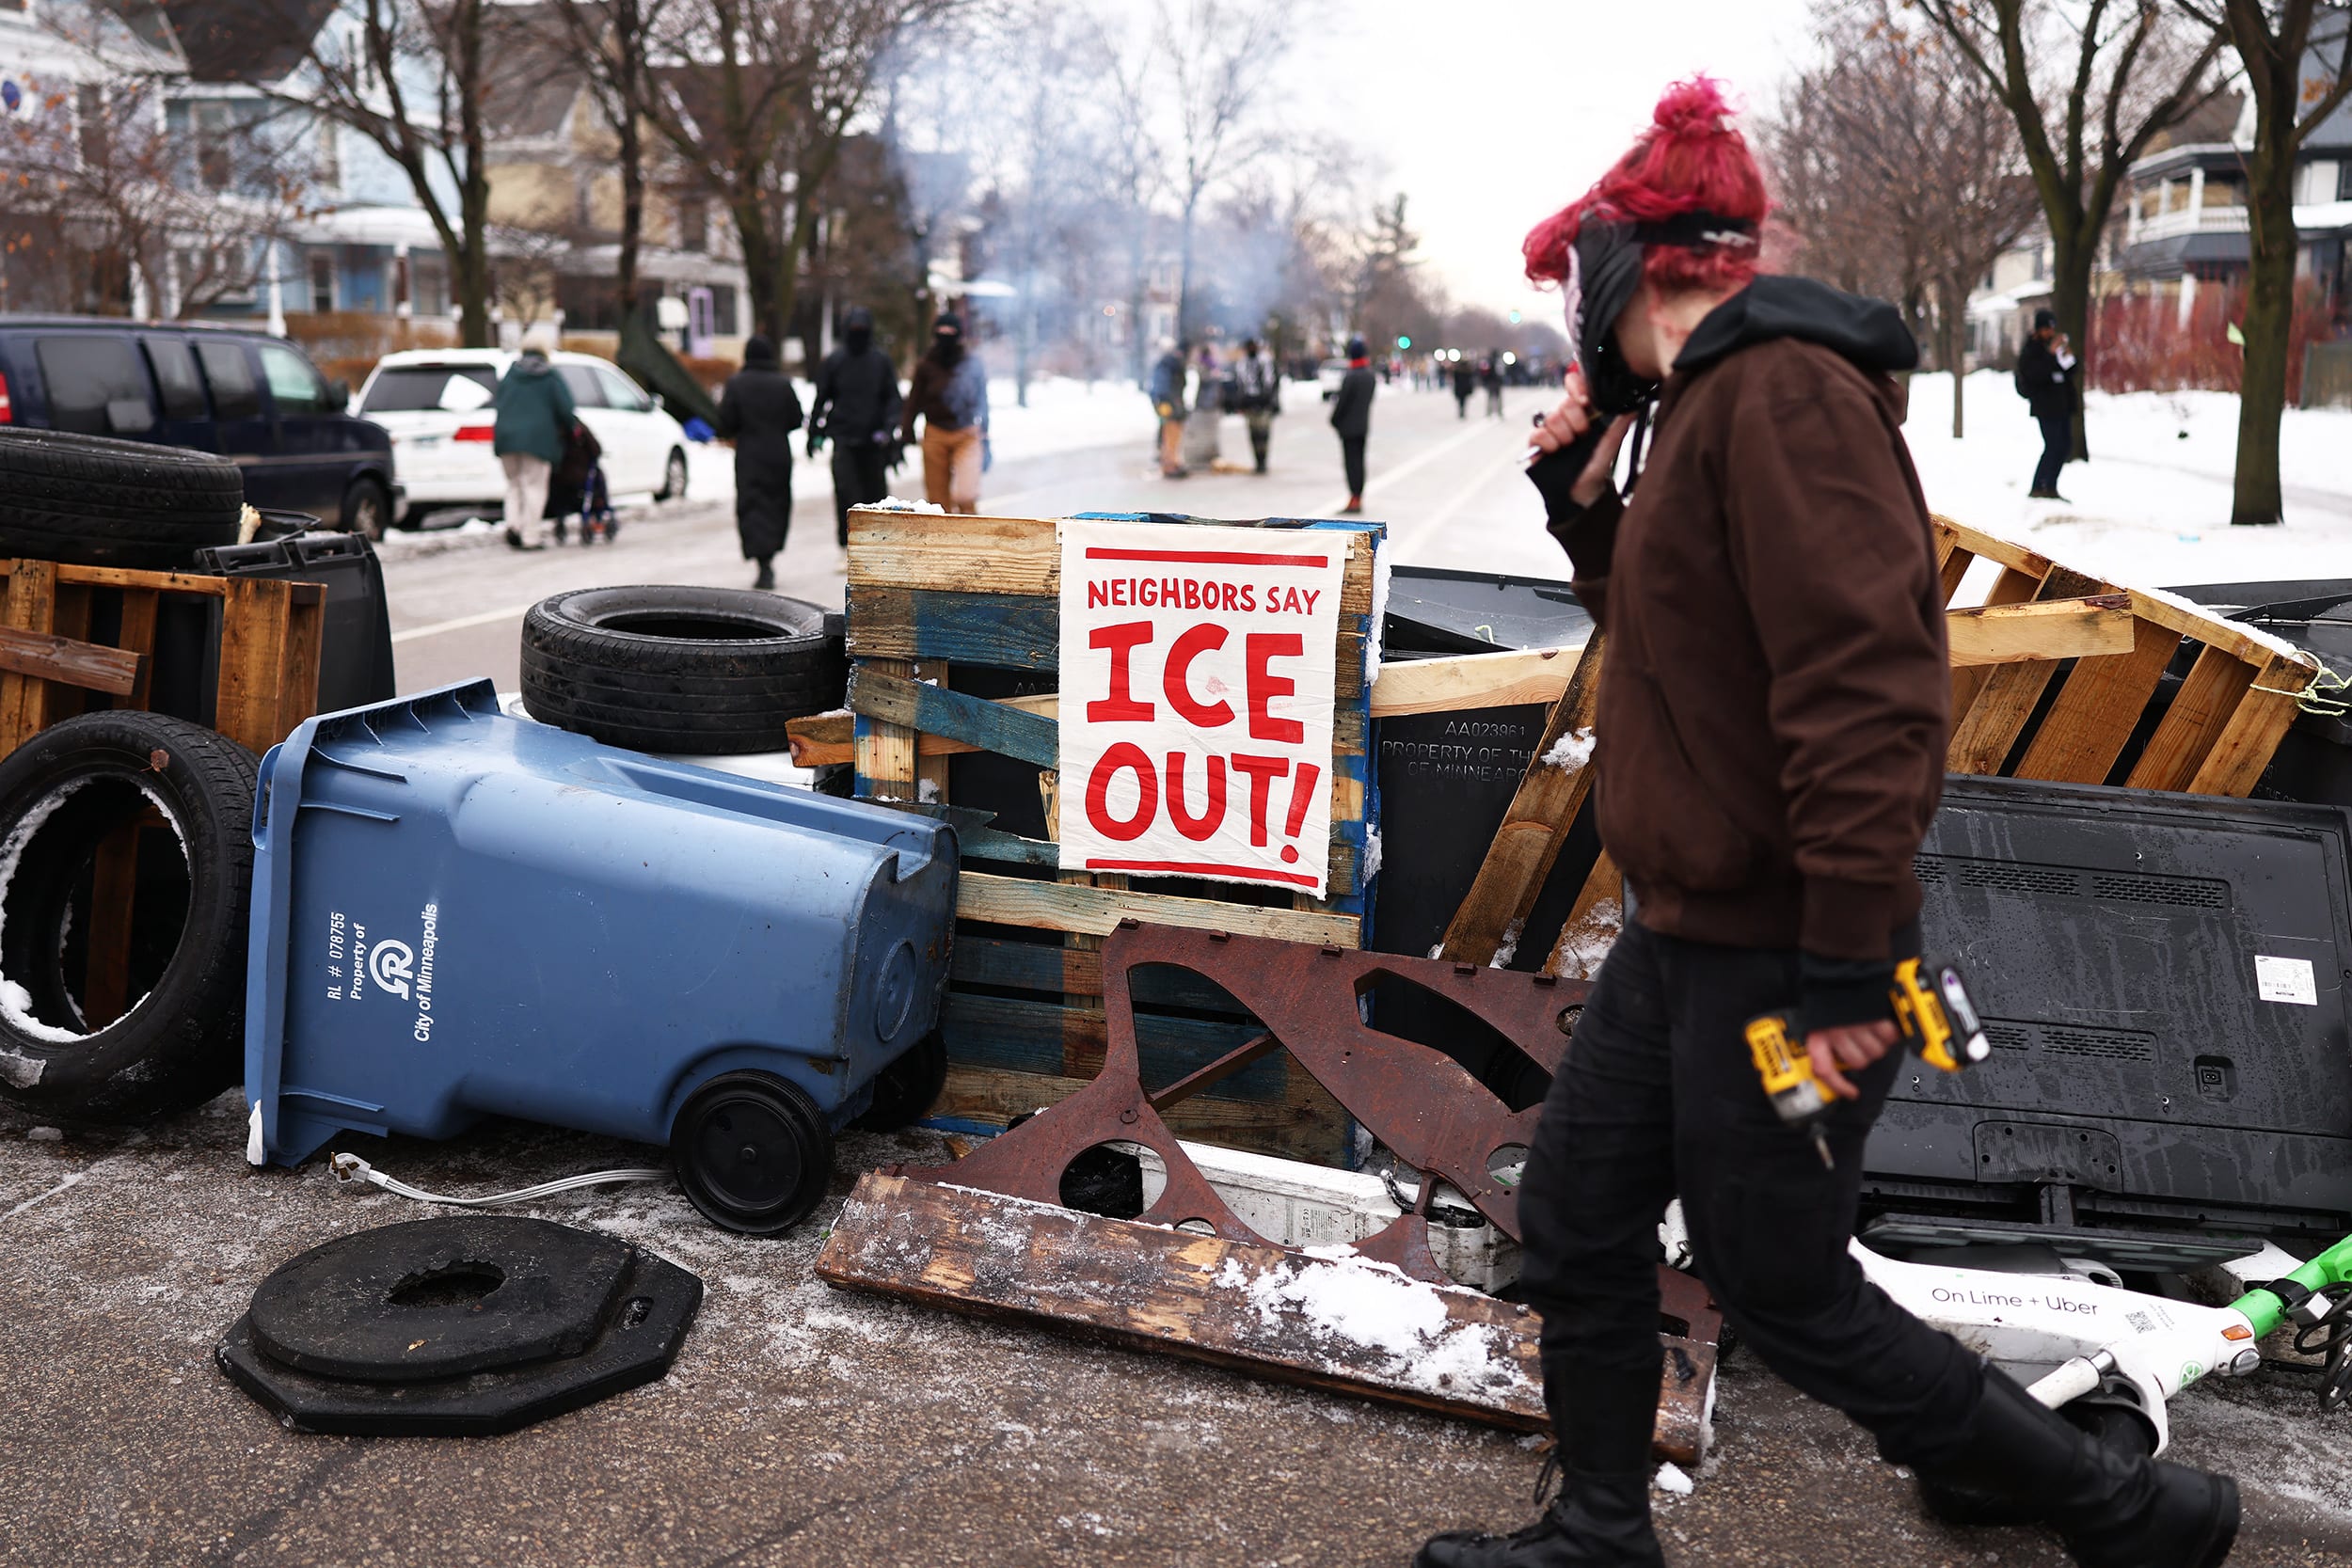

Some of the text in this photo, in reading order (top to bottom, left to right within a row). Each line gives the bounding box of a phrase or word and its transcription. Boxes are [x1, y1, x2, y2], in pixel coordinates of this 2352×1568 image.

[1088, 578, 1321, 616] NEIGHBORS SAY
[1087, 620, 1305, 744] ICE
[1382, 740, 1537, 765] PROPERTY OF TH
[1408, 761, 1430, 776] OF
[1085, 741, 1321, 864] OUT!
[326, 911, 346, 1001] RL # 078755
[350, 922, 367, 1001] Property of
[414, 903, 439, 1042] City of Minneapolis
[1931, 1288, 1965, 1304] On
[1969, 1290, 2023, 1307] Lime
[2046, 1295, 2099, 1316] Uber
